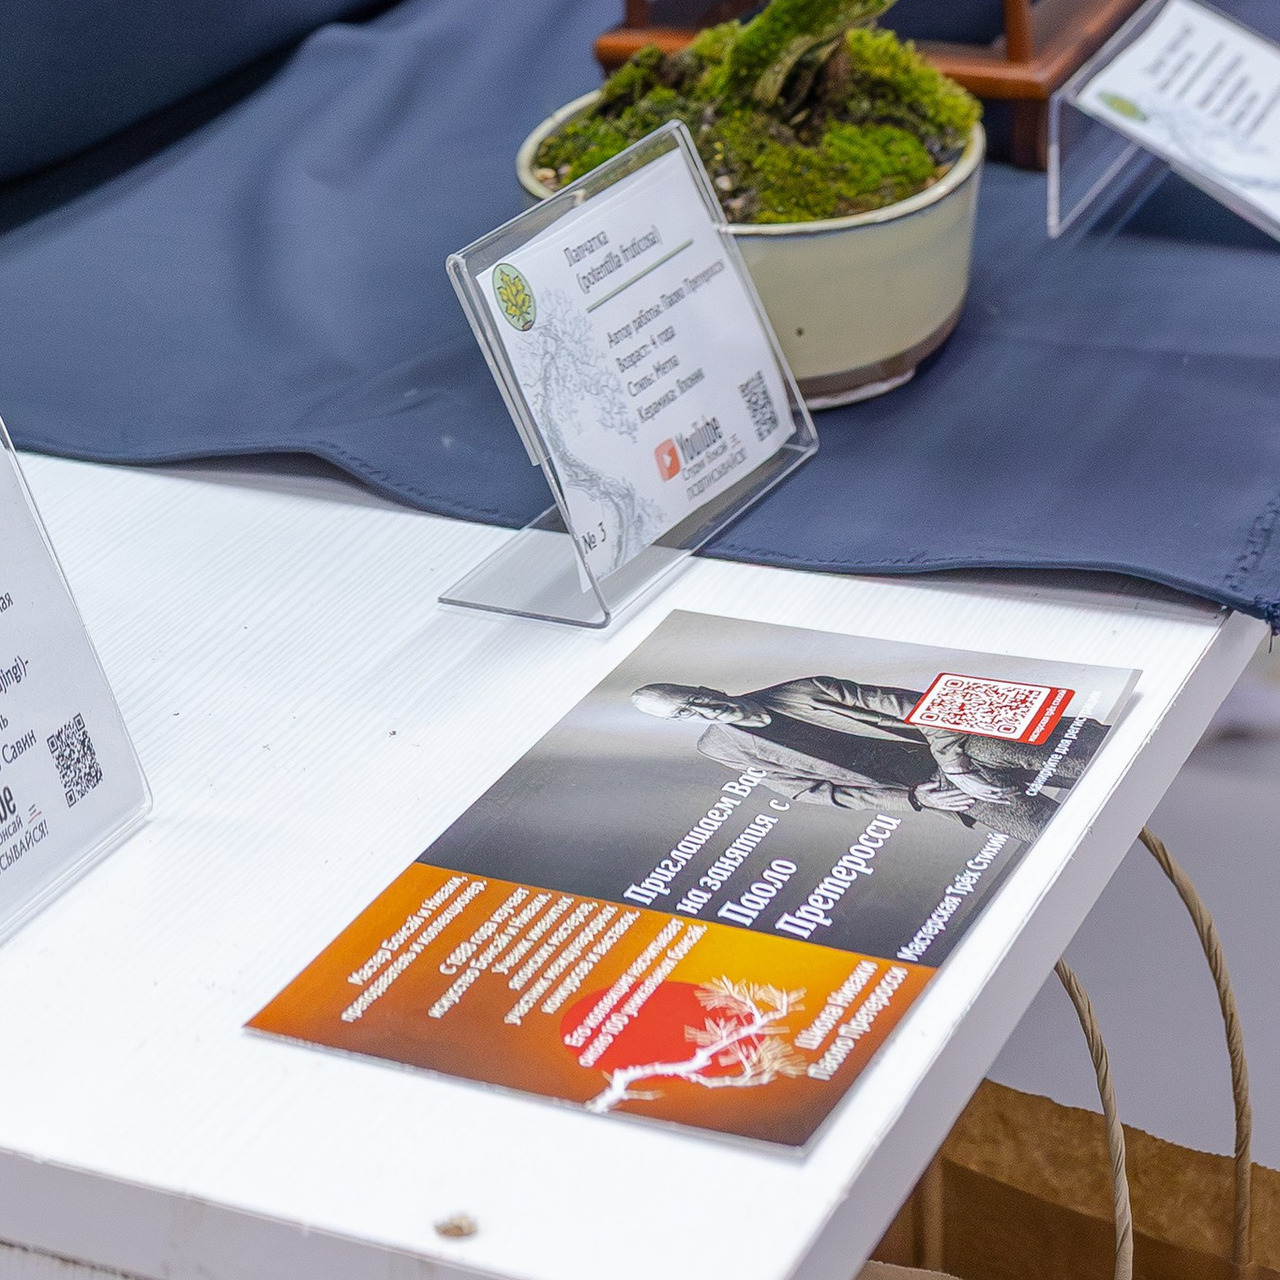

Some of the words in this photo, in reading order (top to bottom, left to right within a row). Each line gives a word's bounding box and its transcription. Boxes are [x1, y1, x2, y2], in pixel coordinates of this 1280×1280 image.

[674, 413, 724, 465] YouTube
[1062, 690, 1106, 739] регистра
[0, 728, 37, 765] Савин
[1022, 752, 1061, 797] сканируйте
[1053, 737, 1073, 755] для
[622, 793, 743, 906] Приглашаем
[724, 764, 770, 798] Вас
[675, 887, 713, 915] на
[698, 812, 777, 891] занятия
[716, 858, 797, 927] Паоло
[774, 810, 905, 939] Претеросси
[895, 893, 963, 962] Мастерская
[944, 868, 982, 896] Трёх
[970, 830, 1011, 870] Стихий
[346, 947, 392, 986] Мастер
[600, 1011, 635, 1036] 100
[793, 1003, 845, 1051] Школа
[825, 959, 878, 1007] Ниваки
[805, 1034, 857, 1081] Паоло
[836, 964, 909, 1040] Претеросси
